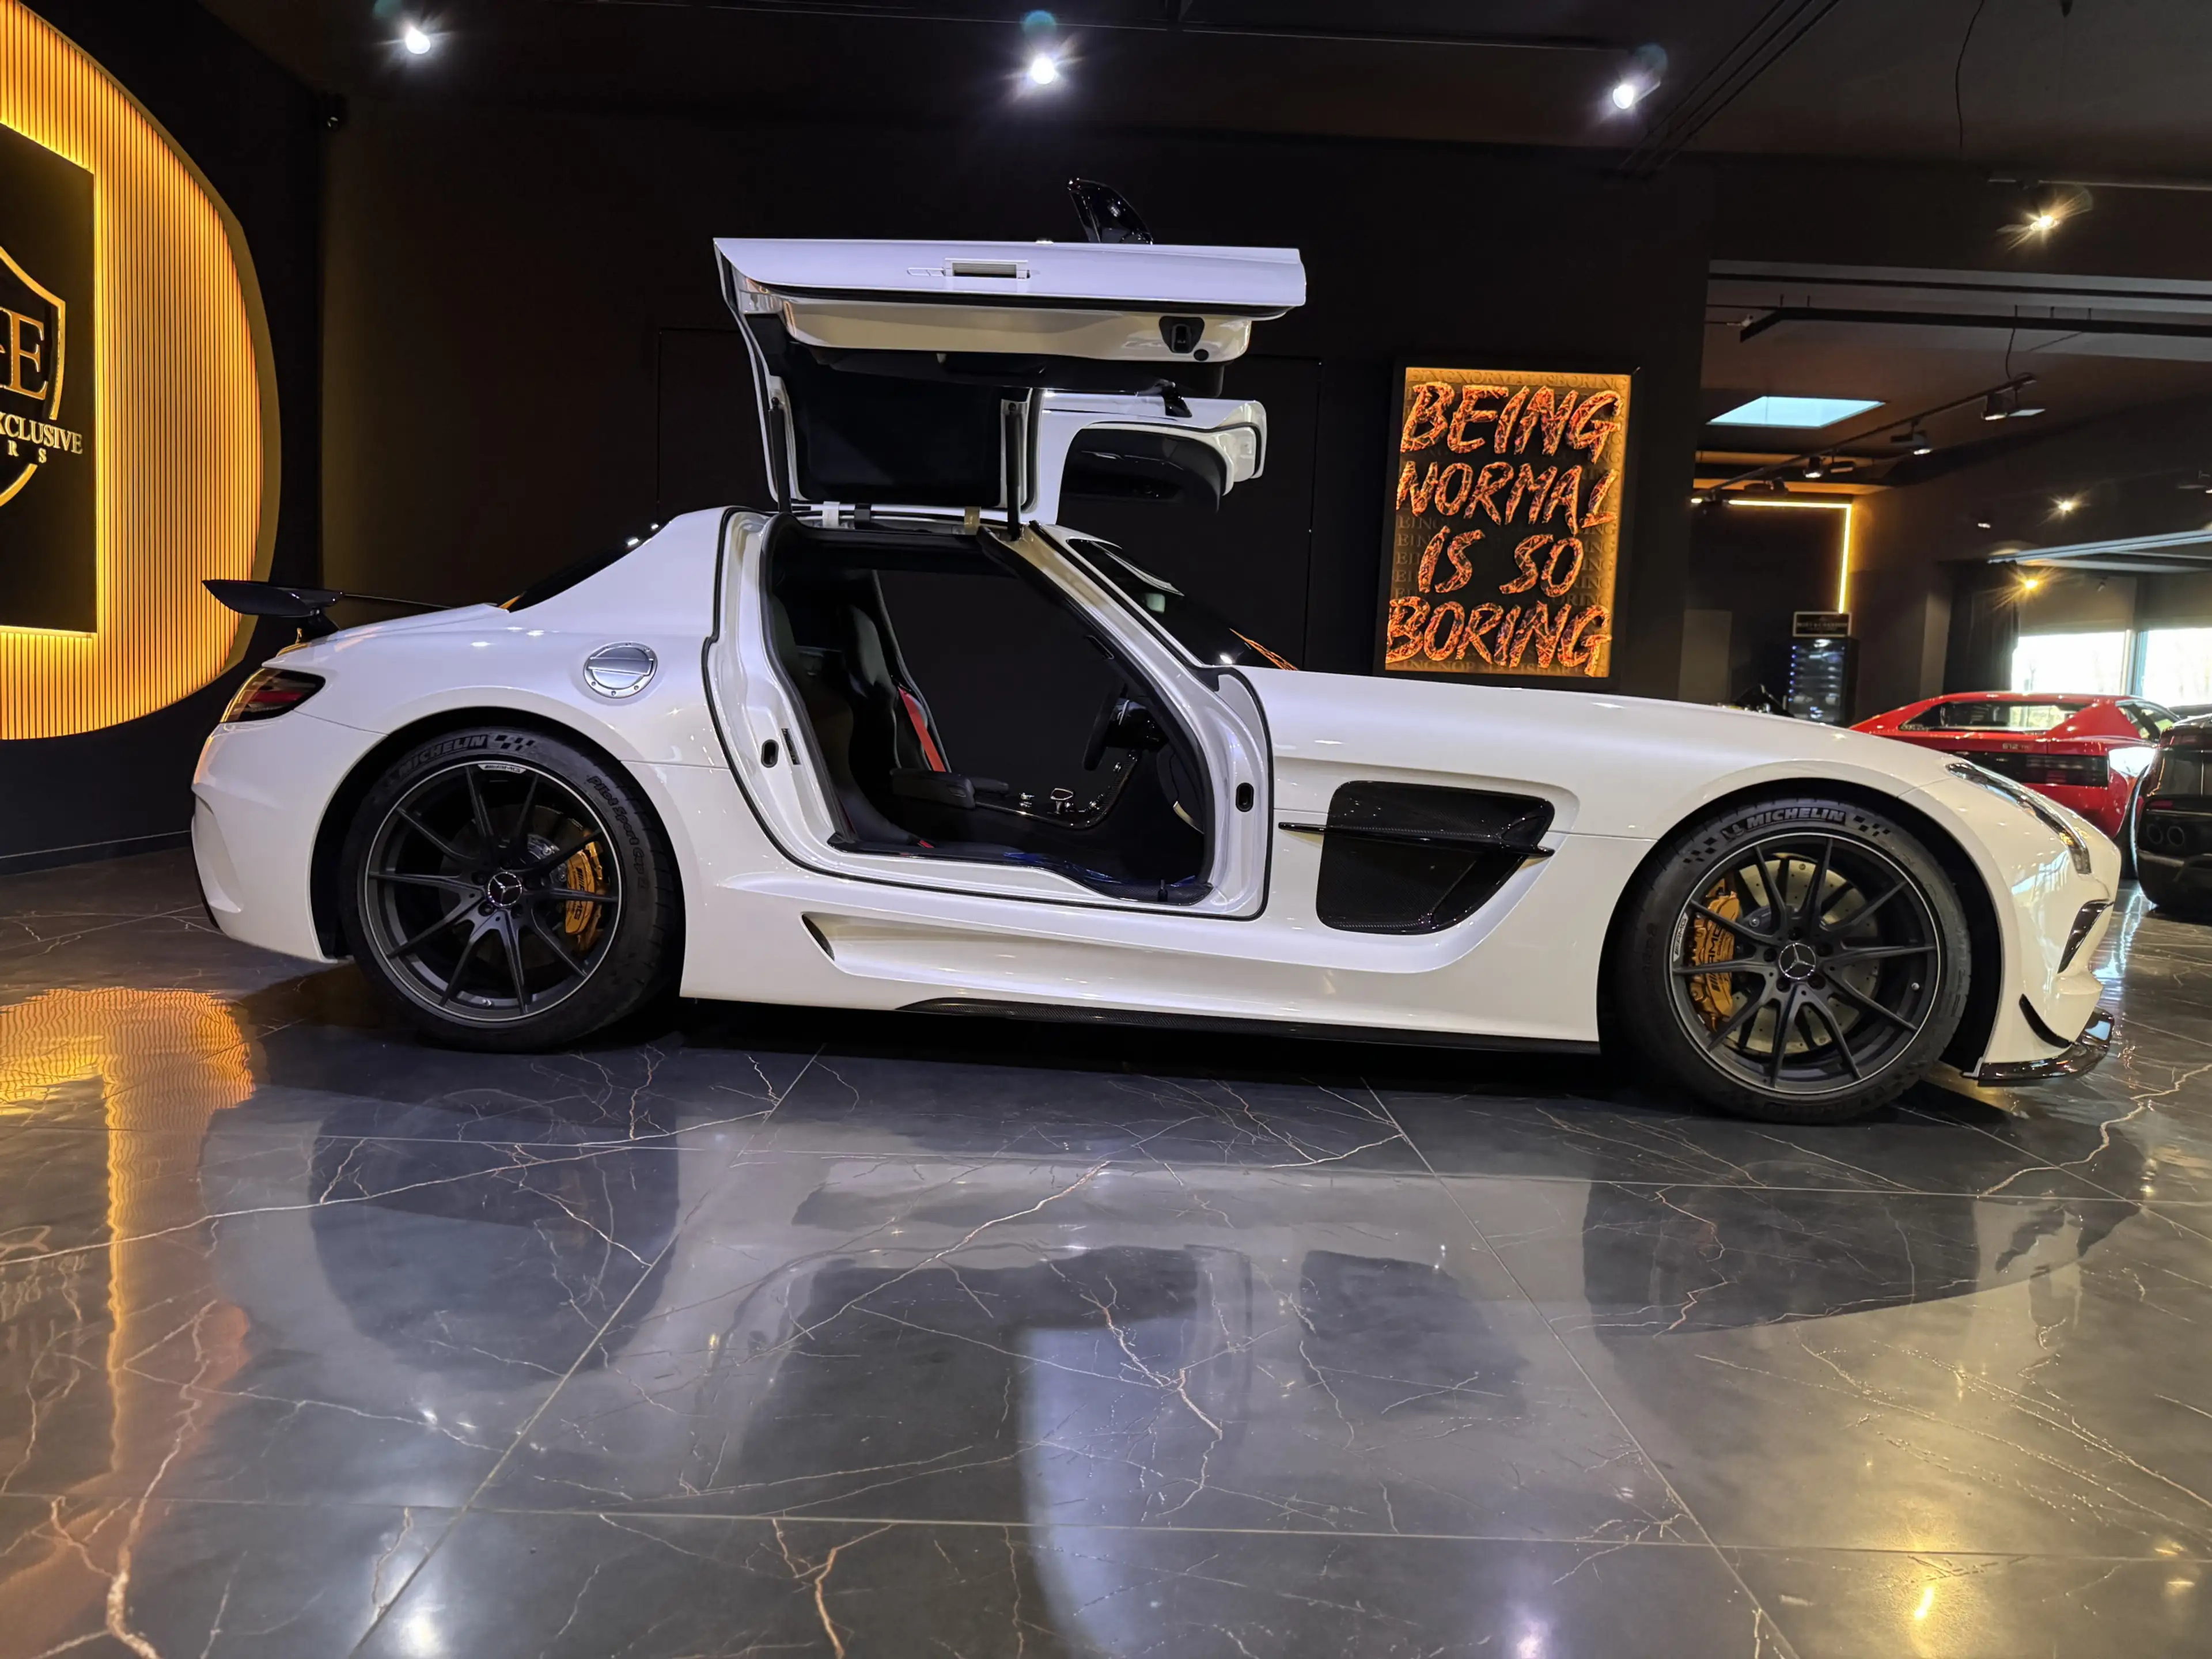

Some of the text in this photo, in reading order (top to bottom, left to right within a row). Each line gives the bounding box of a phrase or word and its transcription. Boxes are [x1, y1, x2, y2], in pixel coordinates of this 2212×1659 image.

[1401, 381, 1622, 464] BEING
[1396, 461, 1618, 536] NORMAL
[1418, 525, 1584, 597] IS SO
[1385, 596, 1612, 677] BORING
[399, 735, 486, 779] MICHELIN
[588, 775, 619, 806] Pilot
[612, 806, 640, 846] Sport
[632, 847, 645, 874] Cup
[1747, 808, 1845, 830] MICHELIN
